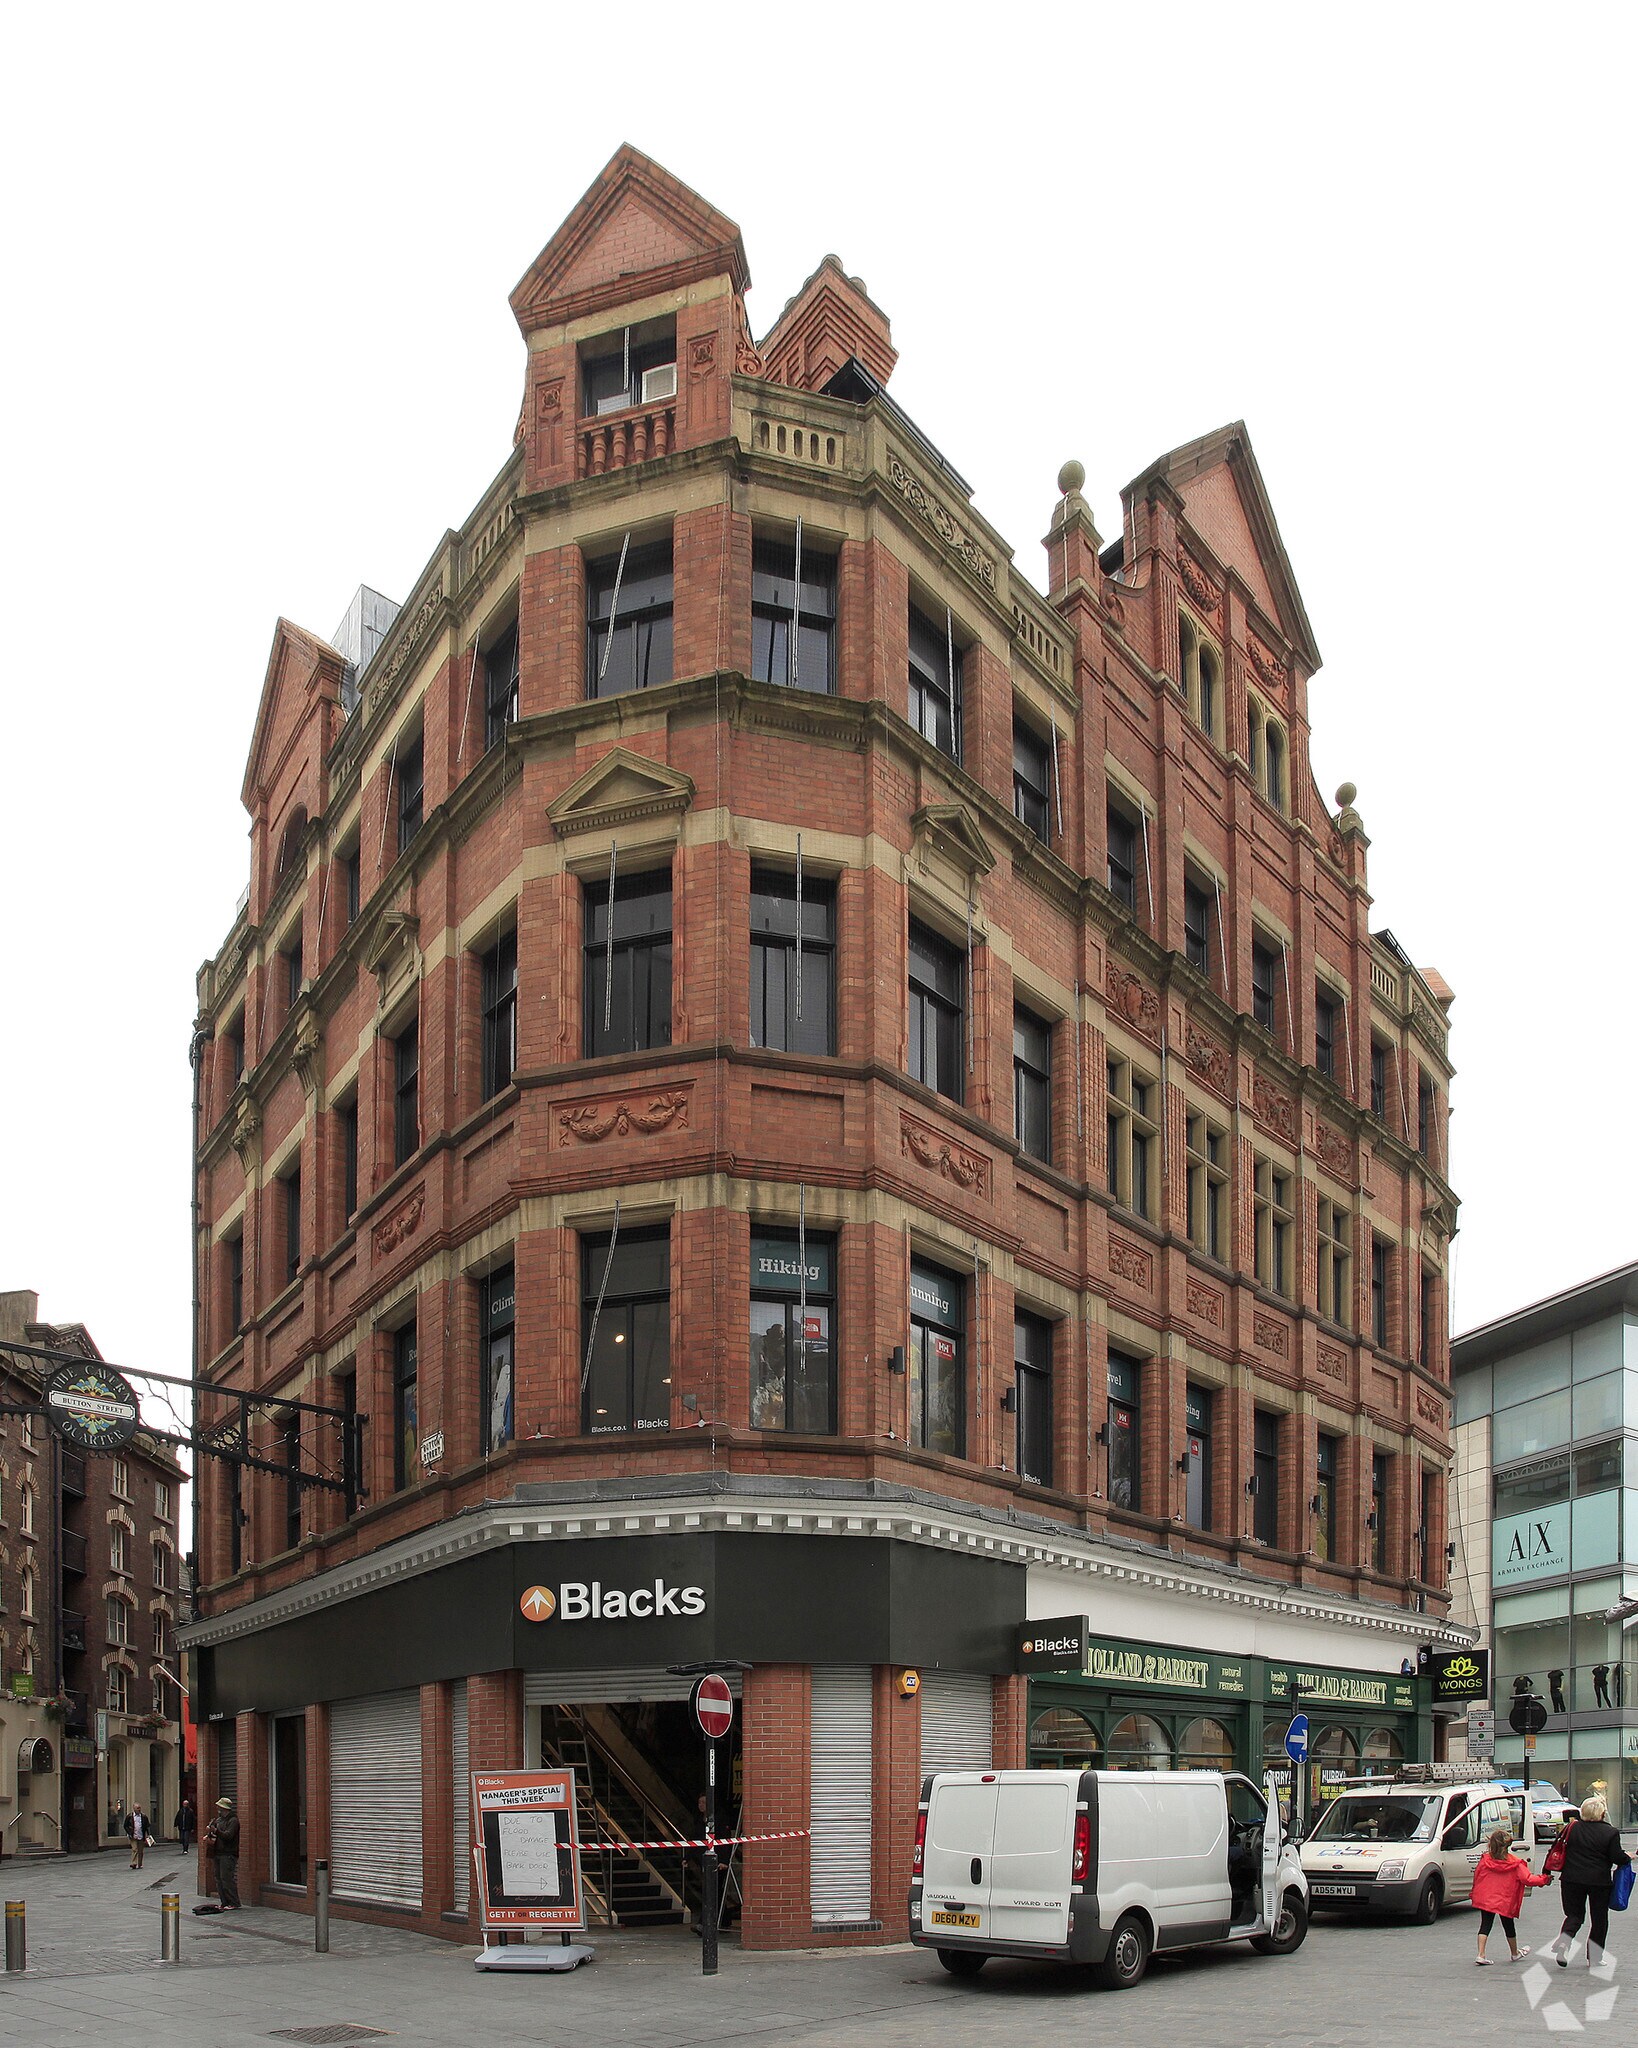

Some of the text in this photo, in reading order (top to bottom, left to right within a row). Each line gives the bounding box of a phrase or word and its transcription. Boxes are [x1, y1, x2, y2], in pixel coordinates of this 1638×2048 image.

[759, 1258, 820, 1280] Hiking
[491, 1292, 515, 1315] Clim
[910, 1286, 950, 1313] unning
[52, 1365, 132, 1402] THE CAVERN
[1107, 1373, 1122, 1386] avel
[62, 1397, 123, 1414] BUTTON STREET
[637, 1419, 669, 1429] Blacks
[62, 1421, 124, 1445] QUARTER
[1497, 1557, 1565, 1576] ARMANI EXCHANGE
[560, 1578, 706, 1620] Blacks
[1034, 1637, 1079, 1653] Blacks
[1143, 1654, 1156, 1683] &
[1157, 1656, 1209, 1688] BARRETT
[1221, 1667, 1242, 1678] natural
[1270, 1670, 1288, 1683] health
[1218, 1680, 1244, 1692] remedies
[1271, 1685, 1287, 1696] food
[1340, 1678, 1349, 1700] &
[1350, 1680, 1388, 1704] BARRETT
[1440, 1679, 1483, 1690] WONGS
[1263, 1770, 1292, 1785] HRRY!
[481, 1787, 560, 1800] MANAGER'S SPECIAL
[522, 1795, 545, 1803] WEEK
[504, 1816, 543, 1825] DUE TO
[504, 1849, 528, 1857] PLEASE
[506, 1862, 525, 1870] BACK
[1314, 1887, 1353, 1895] AD55 MYU
[935, 1913, 977, 1926] DE60 MZY
